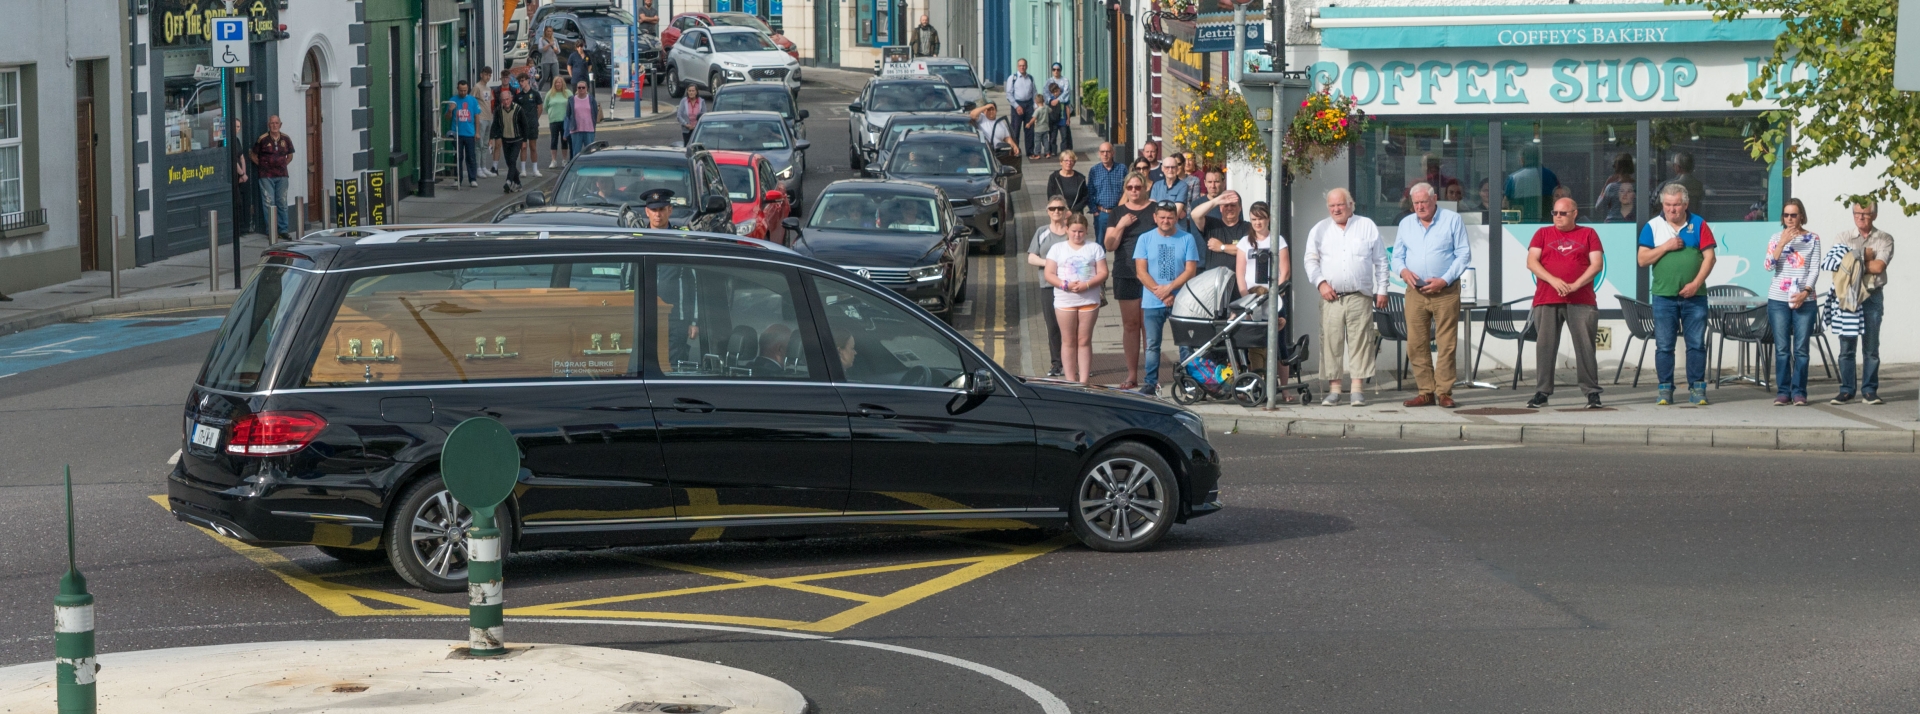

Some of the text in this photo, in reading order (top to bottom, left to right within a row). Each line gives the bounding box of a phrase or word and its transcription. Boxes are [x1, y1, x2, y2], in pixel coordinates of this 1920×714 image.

[164, 11, 184, 43] OFF
[185, 3, 202, 35] THE
[224, 23, 236, 39] P
[255, 18, 273, 35] LICENCE
[1198, 27, 1236, 38] Leitri
[1497, 27, 1670, 46] COFFEY'S BAKERY
[1310, 59, 1529, 105] COFFEE
[1549, 57, 1698, 103] SHOP
[169, 165, 181, 184] WINES
[181, 167, 195, 182] BEERS
[199, 164, 215, 180] SPIRITS
[346, 185, 357, 207] OFF
[371, 177, 384, 198] OFF
